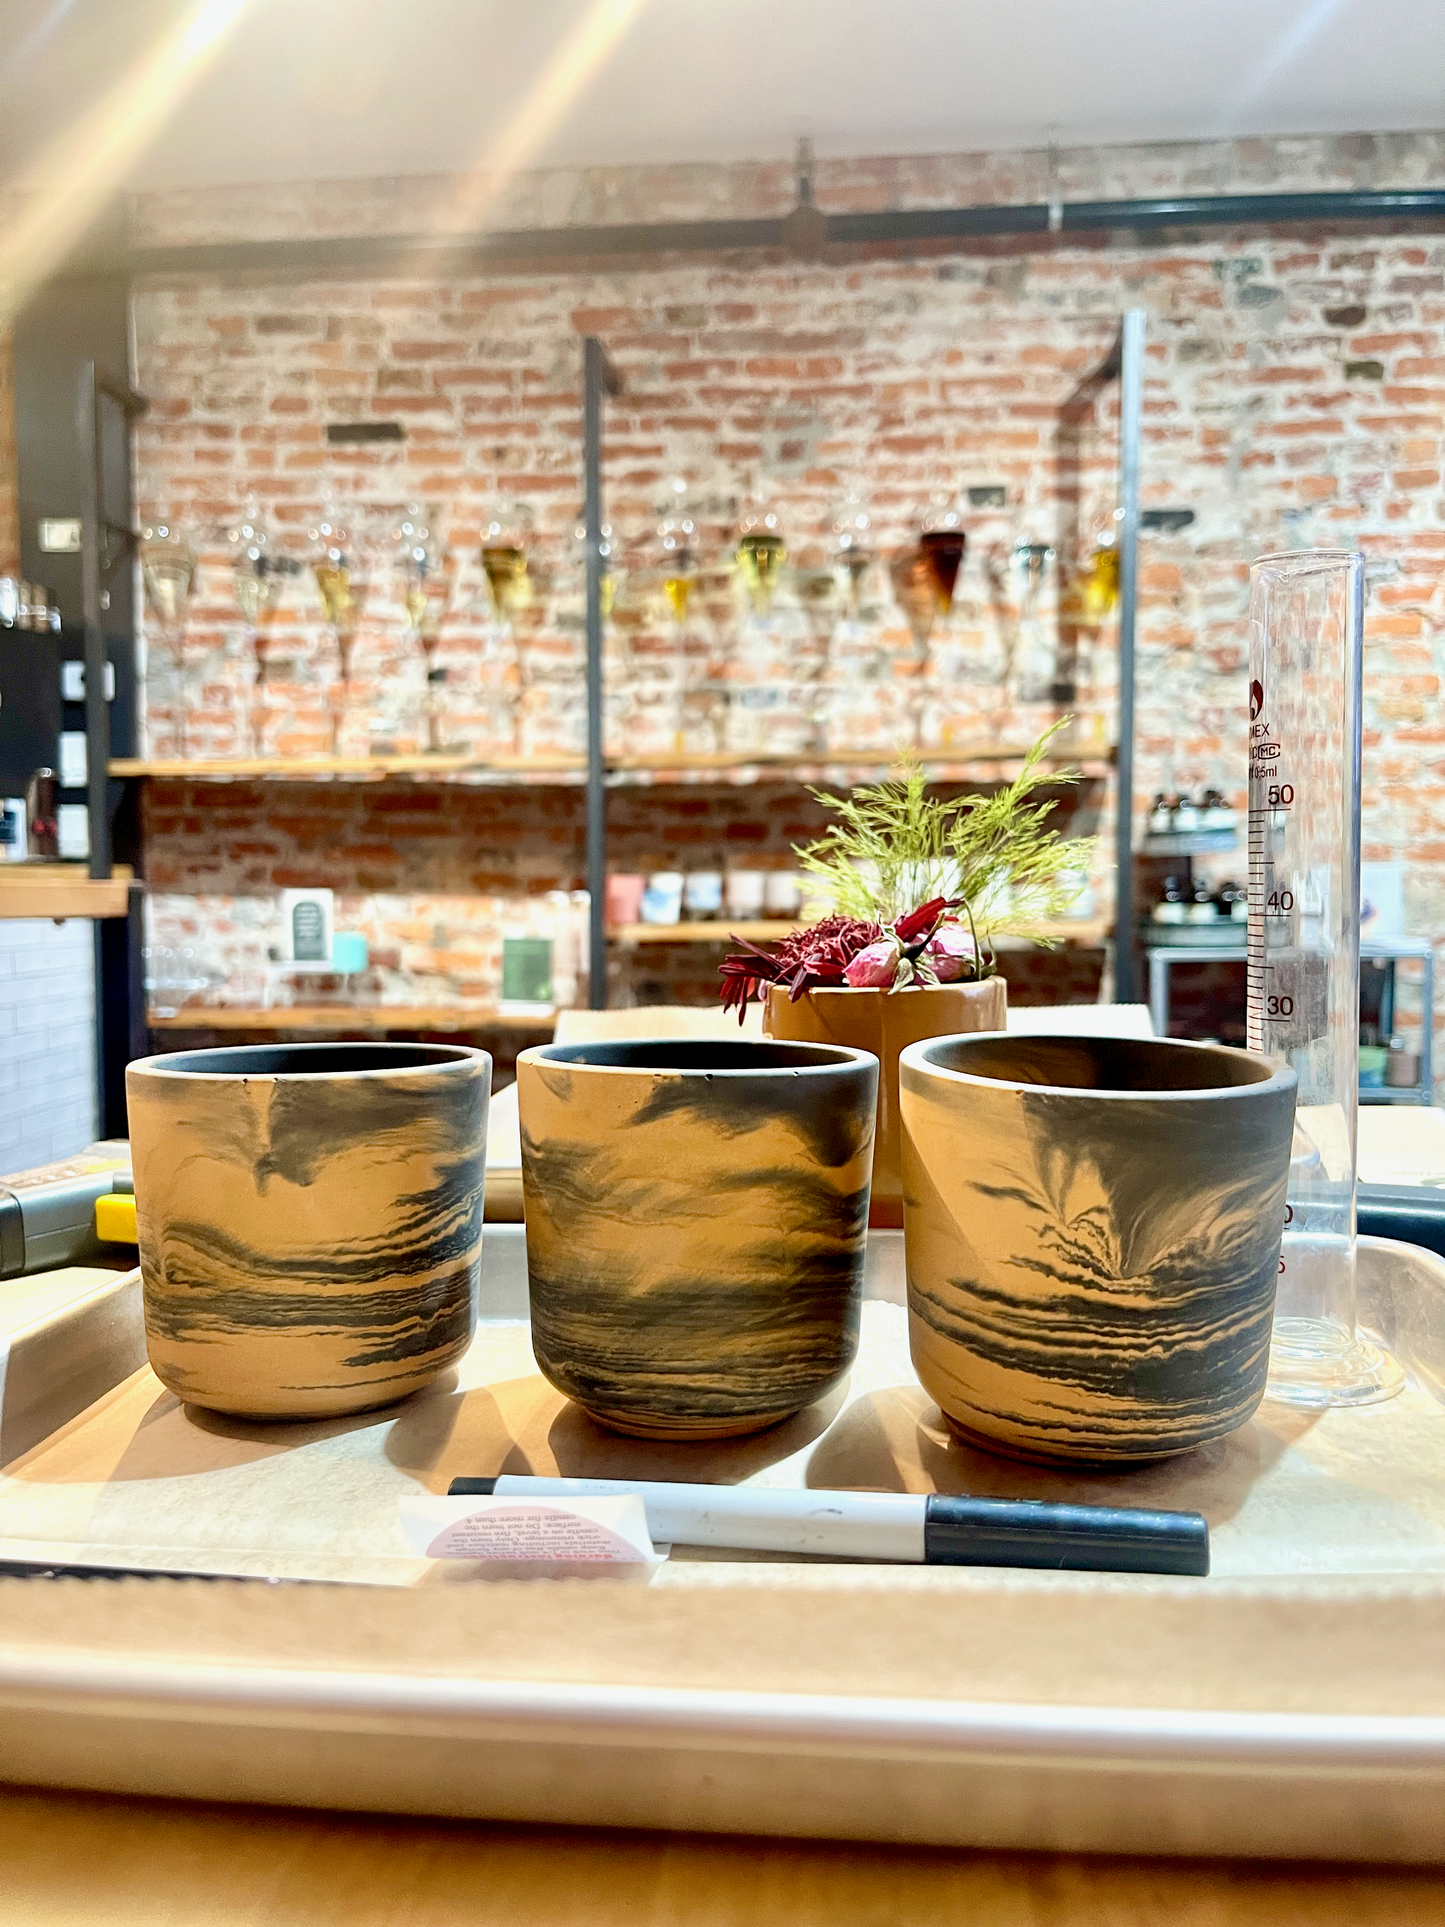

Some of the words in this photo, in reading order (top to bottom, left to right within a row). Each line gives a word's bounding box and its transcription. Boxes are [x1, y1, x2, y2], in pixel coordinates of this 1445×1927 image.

[1268, 784, 1294, 805] 50
[1267, 891, 1294, 911] 40
[1267, 995, 1294, 1016] 30
[545, 1514, 576, 1522] candle
